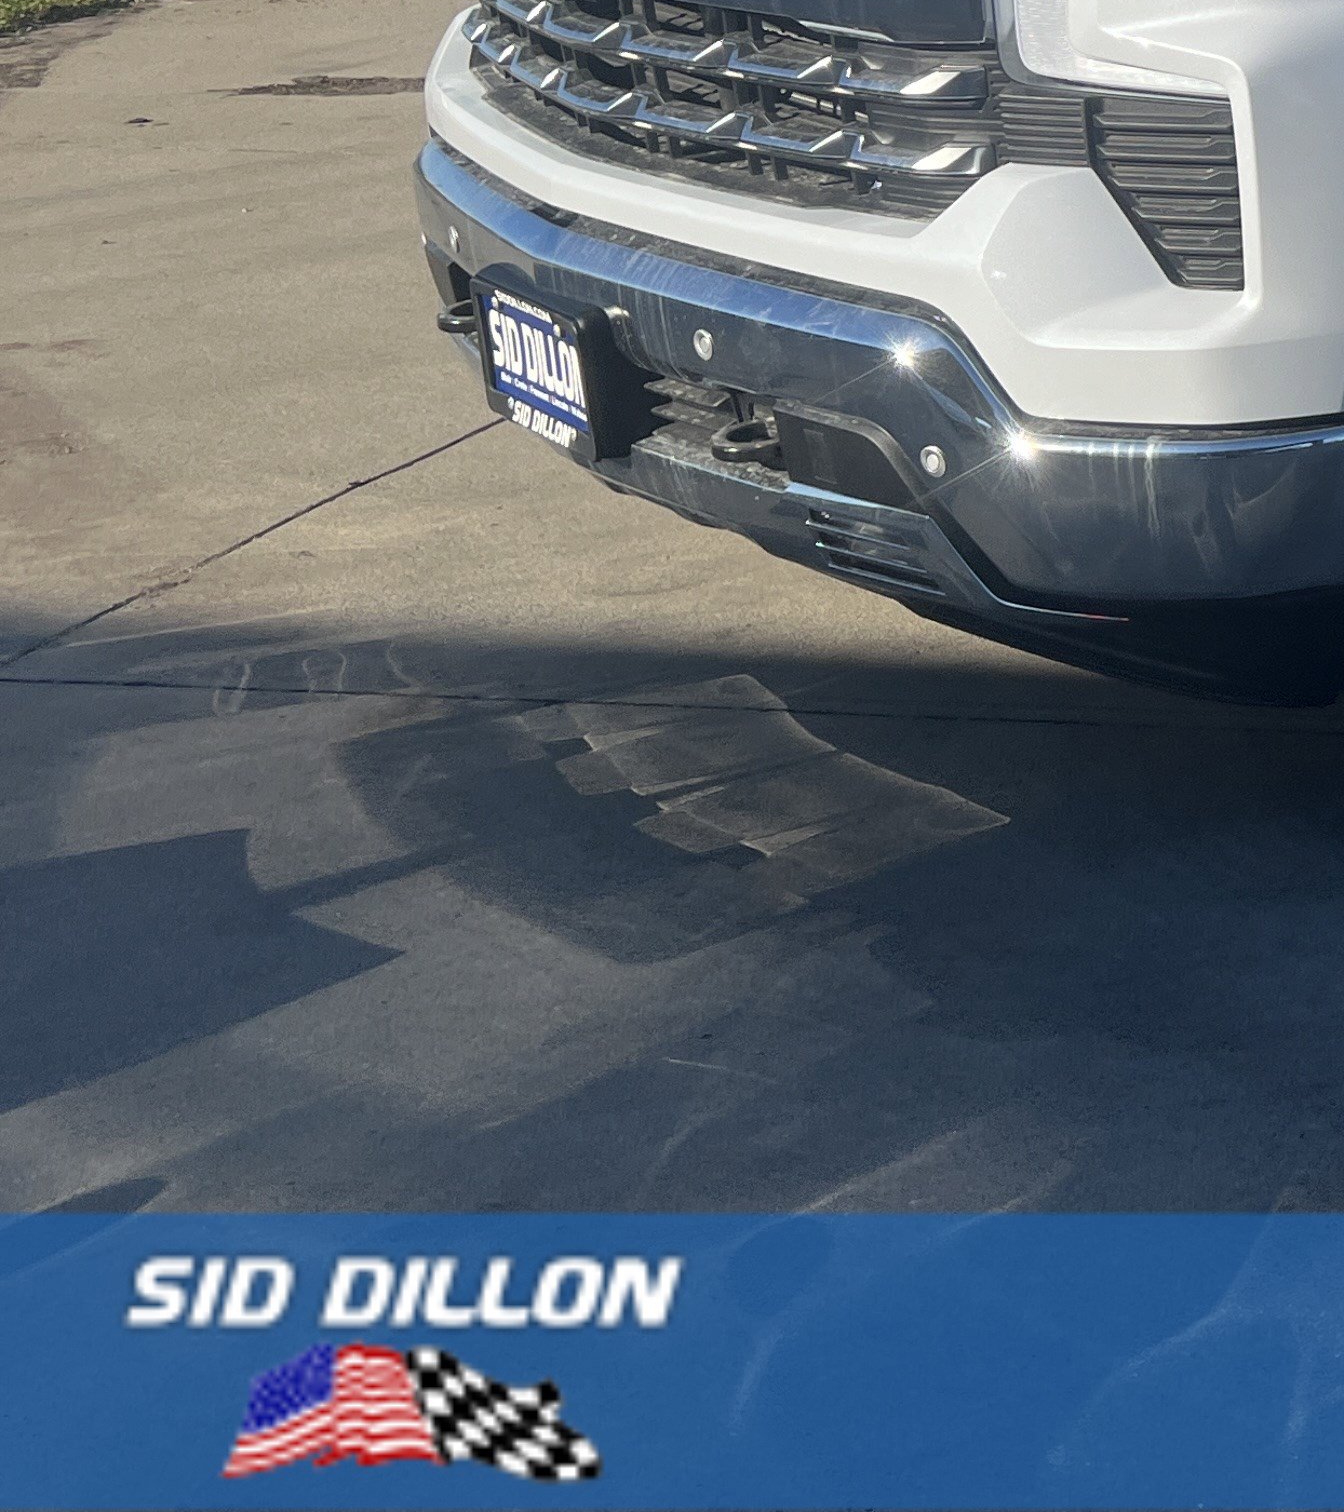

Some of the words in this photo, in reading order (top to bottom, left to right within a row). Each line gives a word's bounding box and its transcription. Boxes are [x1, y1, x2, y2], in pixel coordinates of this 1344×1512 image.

[488, 309, 523, 376] SID
[520, 322, 587, 409] DILLON
[512, 400, 532, 428] SID
[531, 409, 572, 448] DILLON
